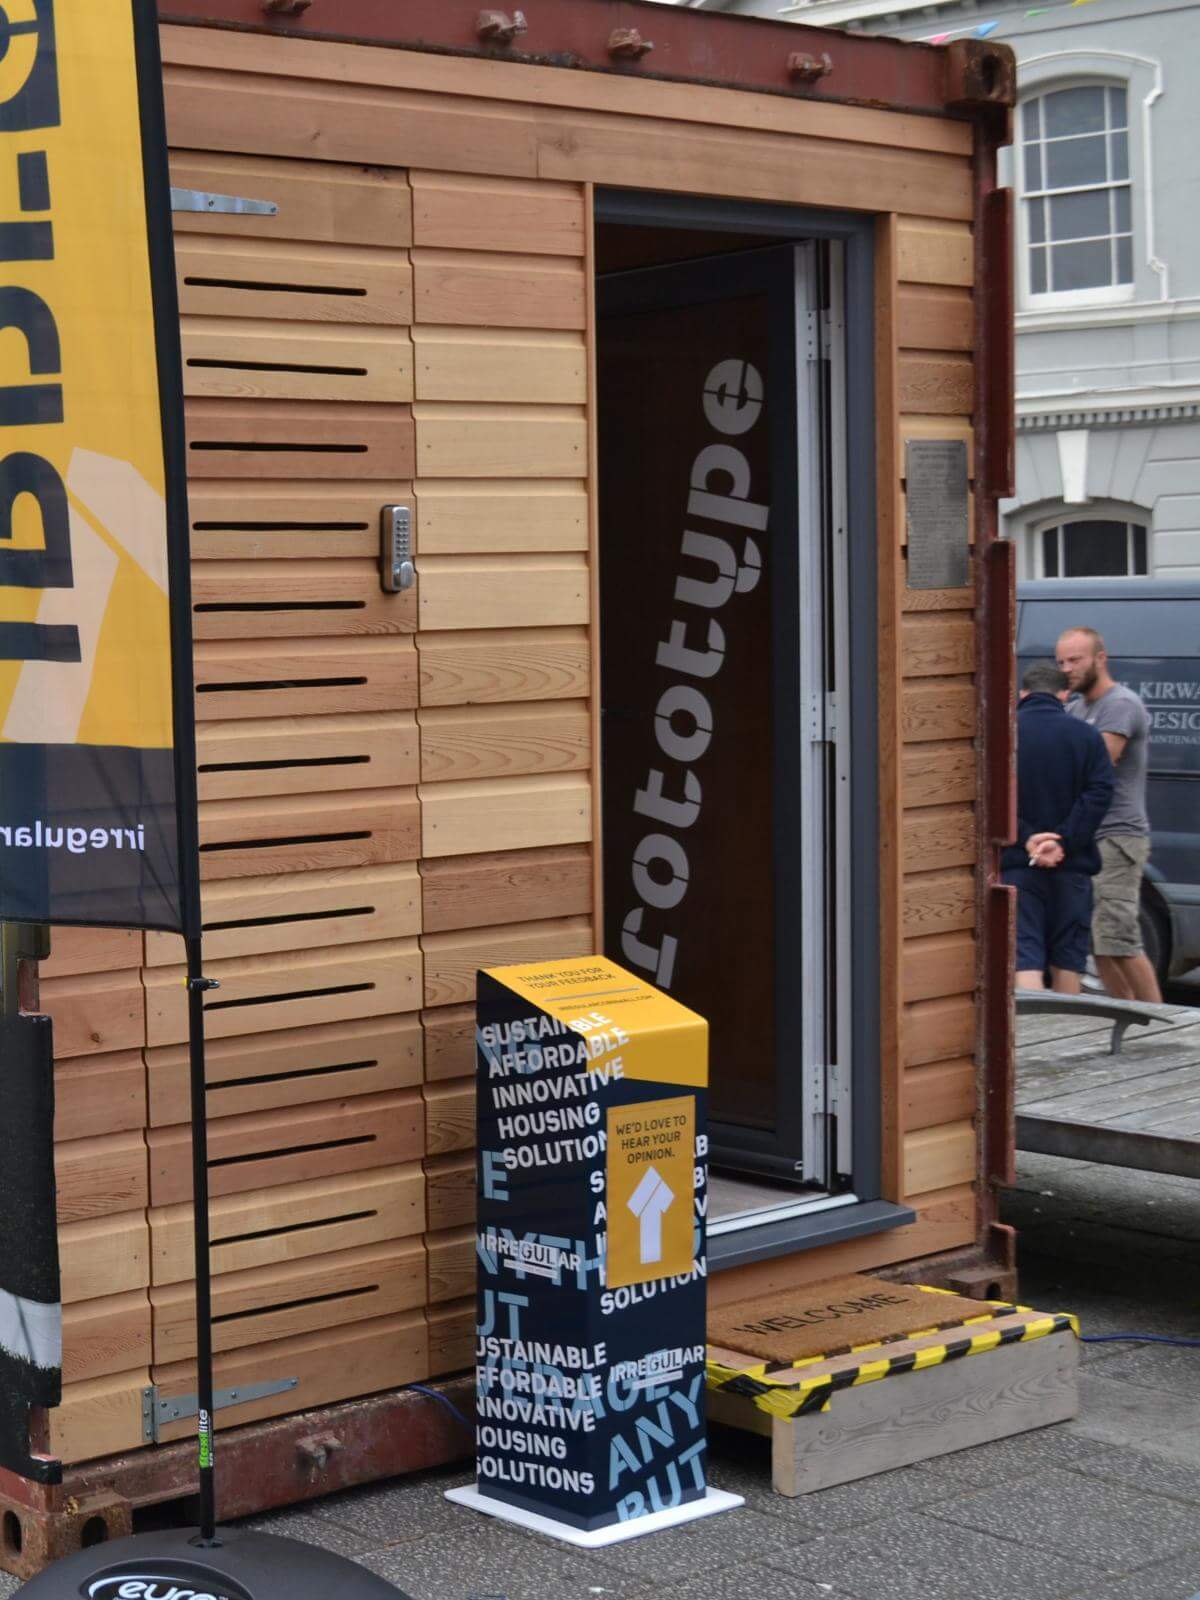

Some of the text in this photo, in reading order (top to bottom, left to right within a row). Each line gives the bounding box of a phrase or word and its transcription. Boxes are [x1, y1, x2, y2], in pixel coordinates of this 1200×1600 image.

[621, 358, 770, 989] rototype
[489, 1027, 629, 1079] AFFORDABLE
[492, 1057, 625, 1109] INNOVATIVE
[497, 1102, 600, 1140] HOUSING
[616, 1115, 687, 1136] WE'D LOVE TO
[621, 1131, 681, 1150] HEAR YOUR
[627, 1148, 675, 1164] OPINION.
[480, 1232, 582, 1272] IRREGULAR
[731, 1293, 910, 1335] WELCOME
[609, 1345, 705, 1384] IRREGULAR
[476, 1425, 568, 1459] OUSING
[608, 1372, 706, 1491] ANY
